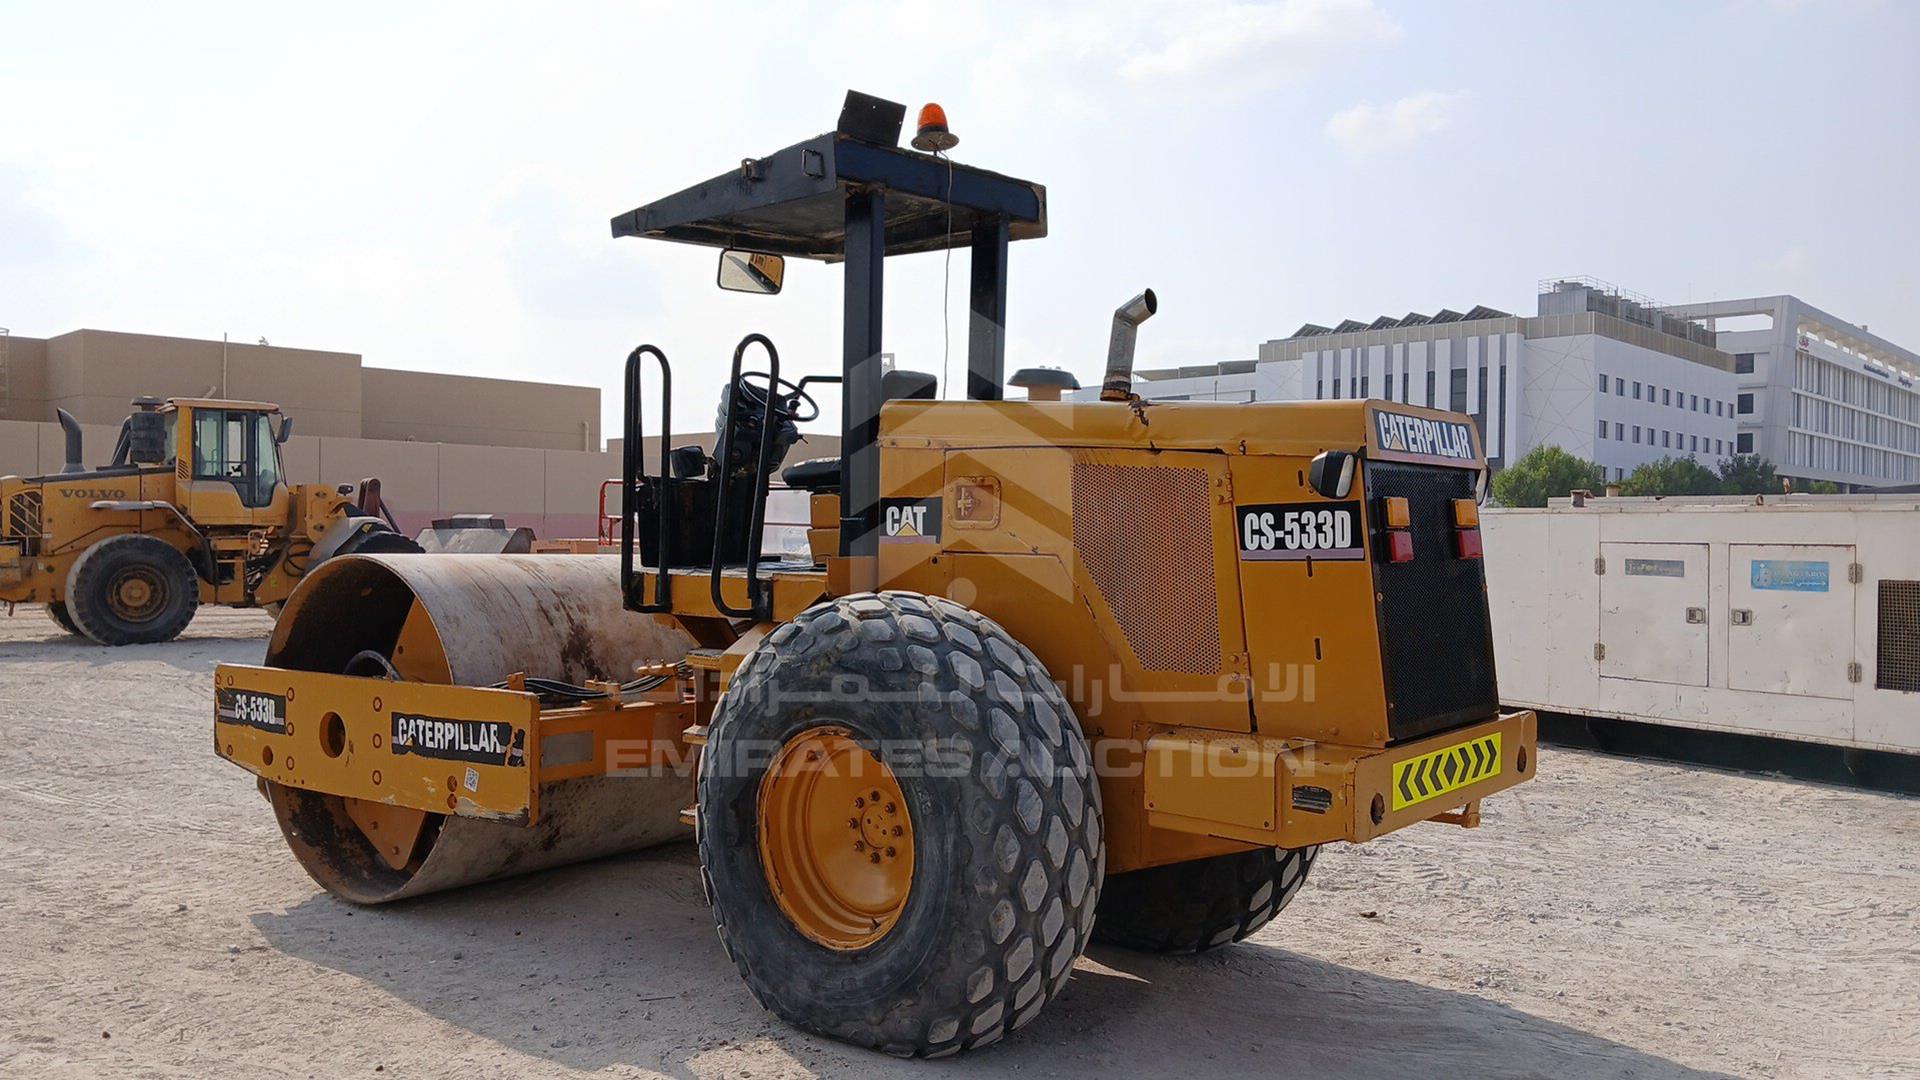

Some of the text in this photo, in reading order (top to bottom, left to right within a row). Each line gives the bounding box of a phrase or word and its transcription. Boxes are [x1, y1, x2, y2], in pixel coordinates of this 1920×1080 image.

[1378, 411, 1473, 460] CATERPILLAR
[59, 488, 126, 499] VOLVO
[885, 505, 927, 537] CAT
[1243, 509, 1352, 551] CS-533D
[234, 693, 276, 725] CS-533D
[398, 717, 502, 754] CATERPILLAR
